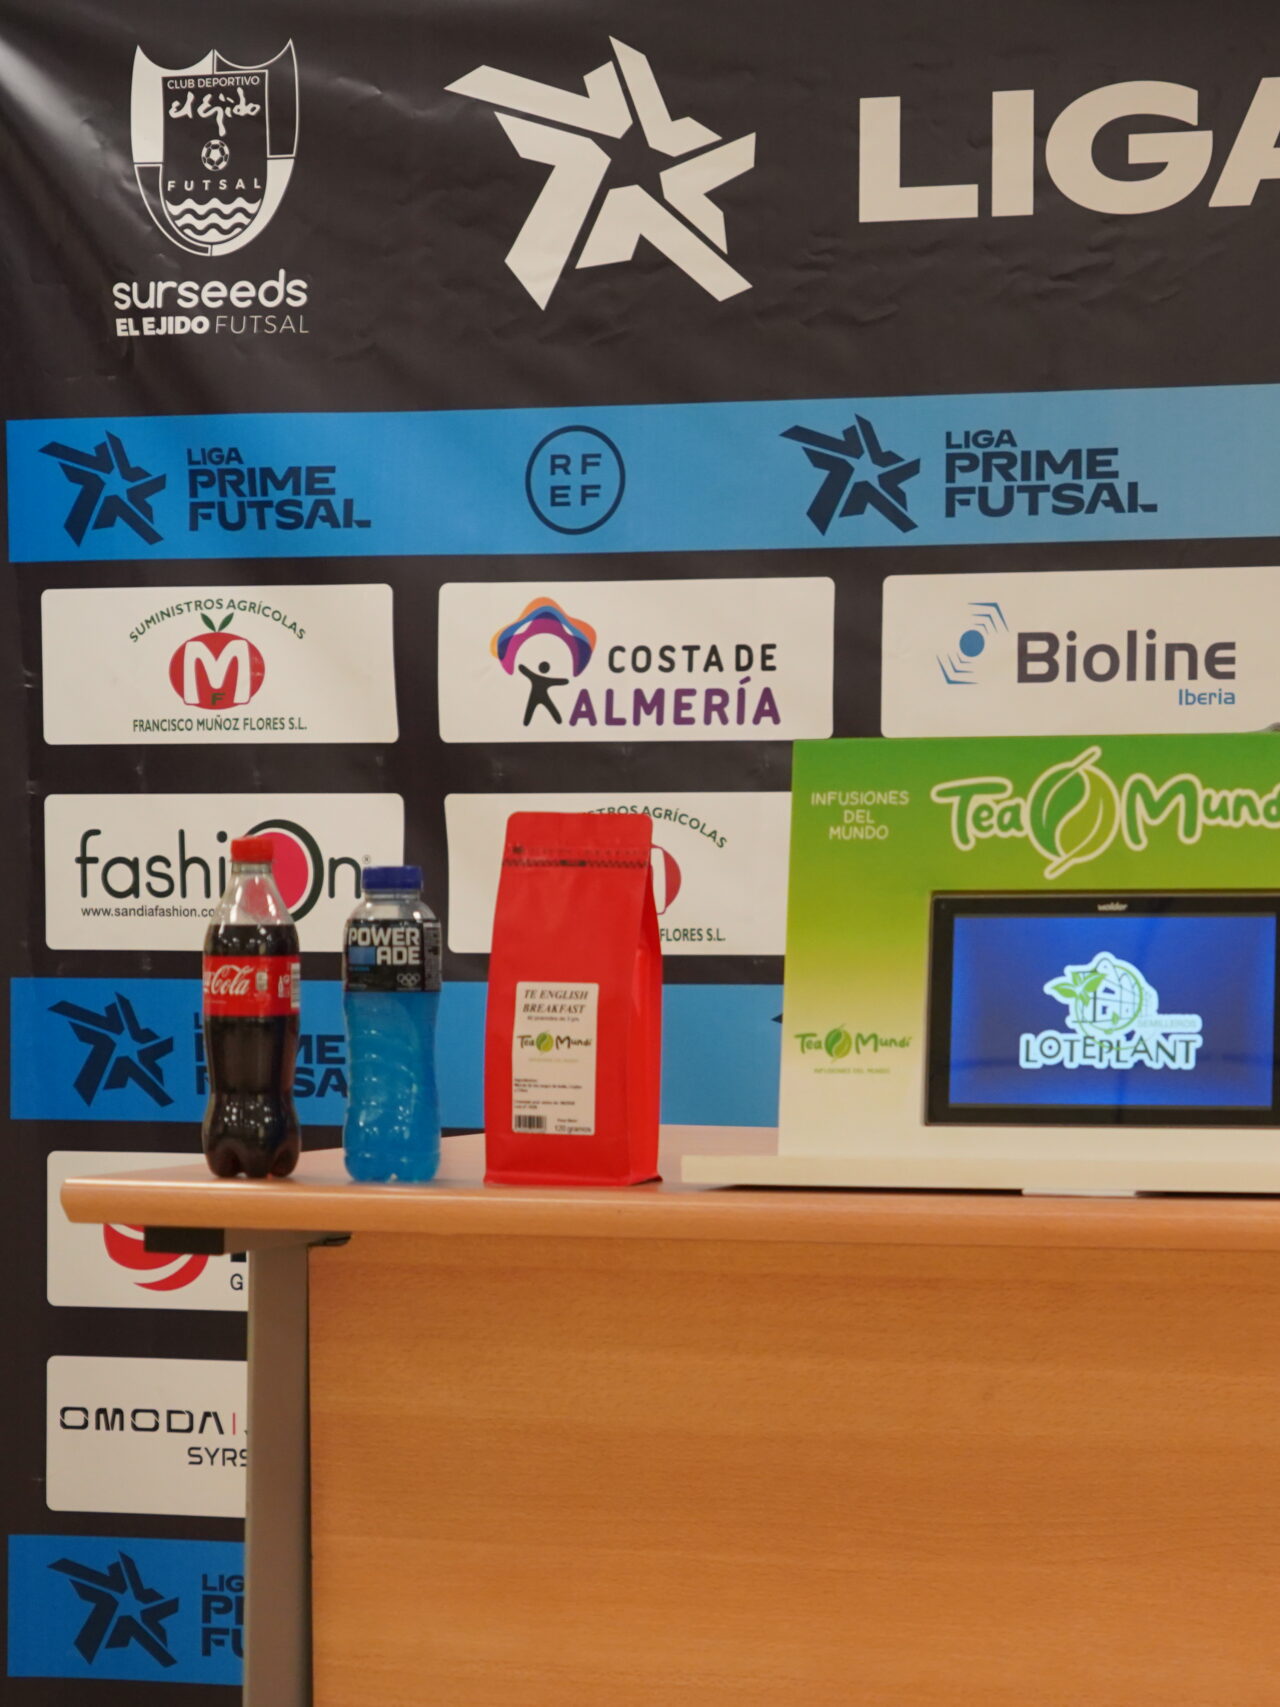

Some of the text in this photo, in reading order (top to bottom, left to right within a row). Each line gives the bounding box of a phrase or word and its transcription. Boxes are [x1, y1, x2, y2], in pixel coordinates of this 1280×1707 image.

[167, 75, 260, 89] CLUB DEPORTIVO
[167, 178, 261, 191] FUTSAL
[112, 268, 308, 311] surseeds
[116, 315, 309, 336] EL EJIDO FUTSAL
[945, 429, 1017, 449] LIGA
[187, 447, 243, 467] LIGA
[945, 447, 1119, 484] PRIME
[188, 465, 337, 499] PRIME
[944, 481, 1158, 518] FUTSAL
[188, 497, 371, 531] FUTSAL
[129, 598, 306, 643] SUMINISTROS AGRÍCOLAS
[608, 643, 778, 674] COSTA DE
[1016, 628, 1237, 684] Bioline
[569, 676, 782, 726] ALMERÍA
[1178, 688, 1236, 706] Iberia
[132, 714, 308, 733] FRANCISCO MUÑOZ FLORES S.L.
[810, 790, 910, 806] INFUSIONES
[843, 808, 875, 824] DEL
[931, 776, 1028, 851] Tea
[641, 805, 728, 849] AGRÍCOLAS
[829, 824, 889, 841] MUNDO
[81, 904, 215, 918] www.sandiafashion.co
[348, 926, 420, 947] POWER
[659, 928, 726, 942] FLORES S.L.
[376, 946, 421, 966] ADE
[540, 989, 589, 1000] ENGLISH
[522, 1003, 586, 1014] BREAKFAST
[793, 1032, 823, 1055] Tea
[1025, 1035, 1197, 1064] LOTEPLANT
[59, 1406, 225, 1435] OMODA
[187, 1447, 247, 1467] SYRS
